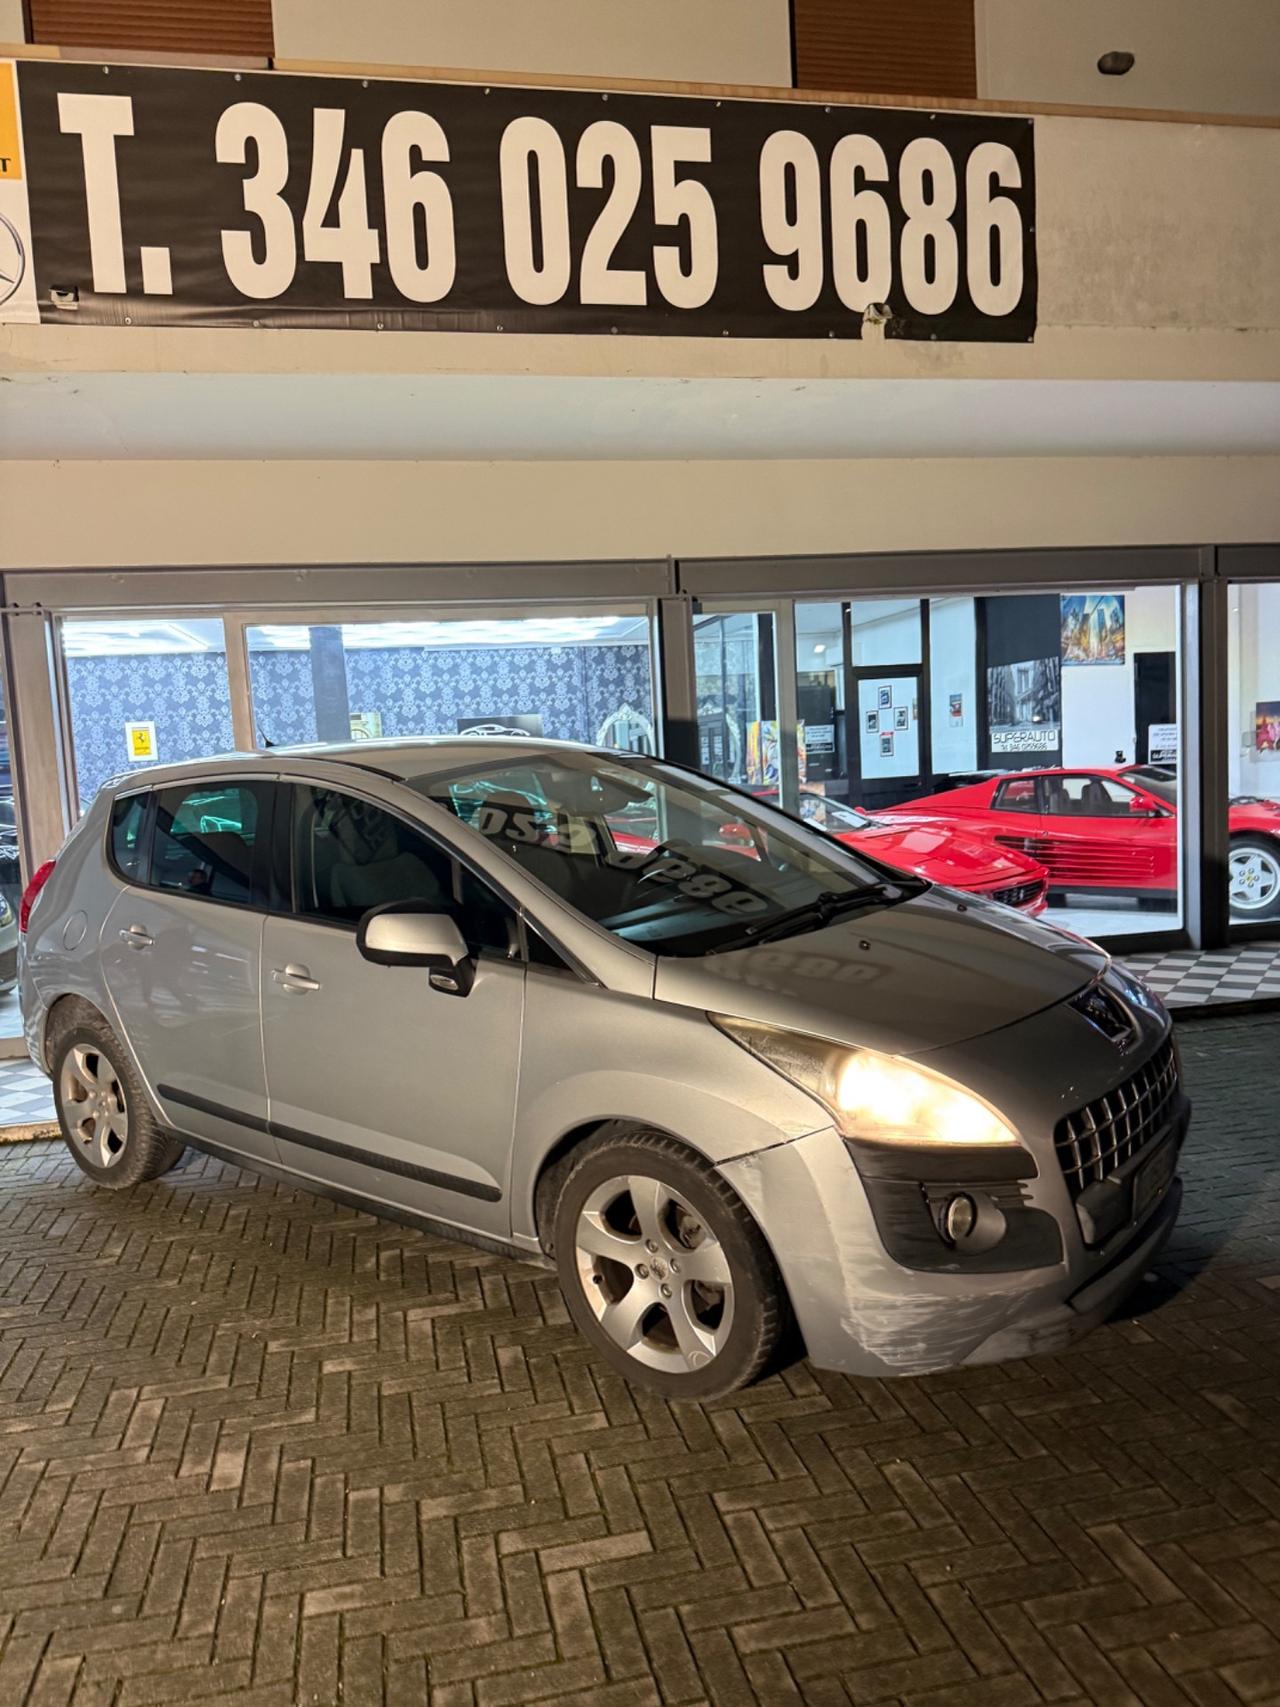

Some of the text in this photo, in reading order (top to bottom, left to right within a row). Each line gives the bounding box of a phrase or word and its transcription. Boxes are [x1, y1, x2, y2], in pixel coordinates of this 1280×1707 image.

[56, 92, 1024, 317] T. 346 025 9686
[993, 730, 1056, 745] SUPERAUTO
